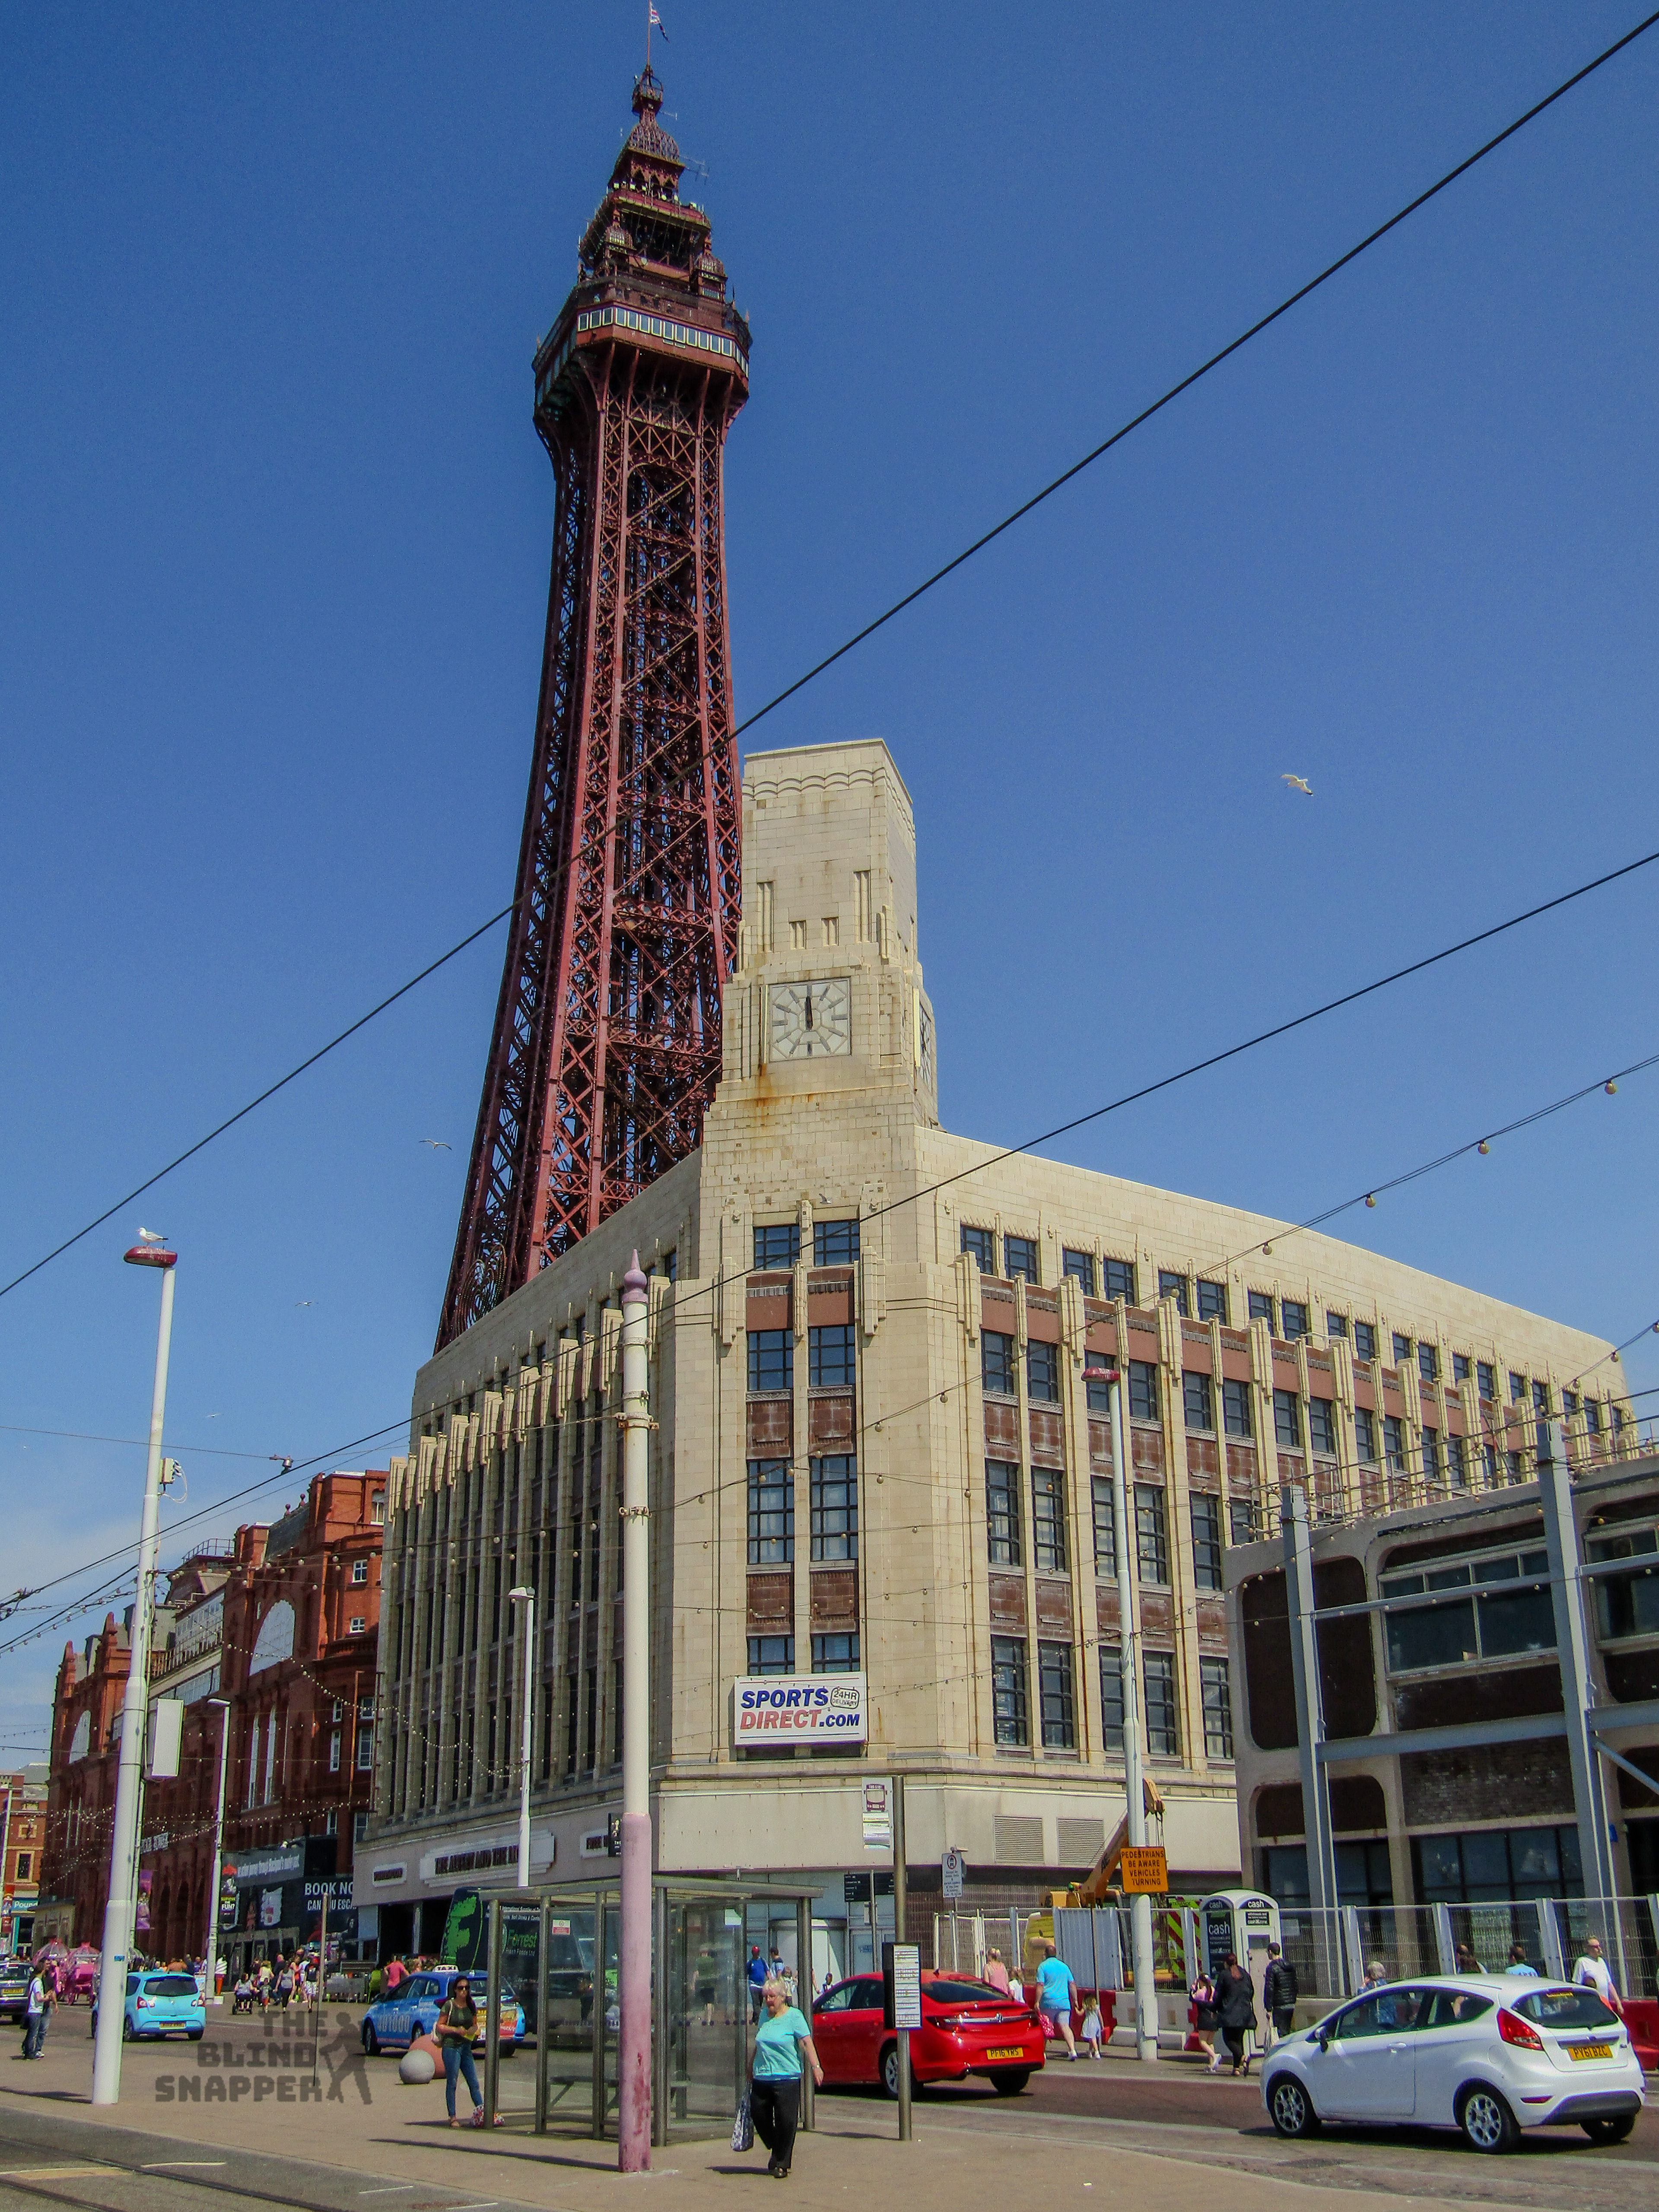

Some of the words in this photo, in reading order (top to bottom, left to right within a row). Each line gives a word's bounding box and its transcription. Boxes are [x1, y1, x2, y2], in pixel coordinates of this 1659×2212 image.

[741, 1687, 829, 1709] SPORTS
[833, 1690, 857, 1700] 24HR
[832, 1698, 857, 1707] DELIVERY
[305, 1881, 337, 1896] BOOK
[340, 1881, 353, 1895] NO
[307, 1900, 321, 1910] CAN
[1209, 1899, 1223, 1908] cash
[1247, 1900, 1265, 1908] cash
[1208, 1921, 1230, 1935] cash
[508, 1929, 537, 1948] Forrest
[1573, 2047, 1592, 2058] PY61
[1593, 2046, 1608, 2056] BZC
